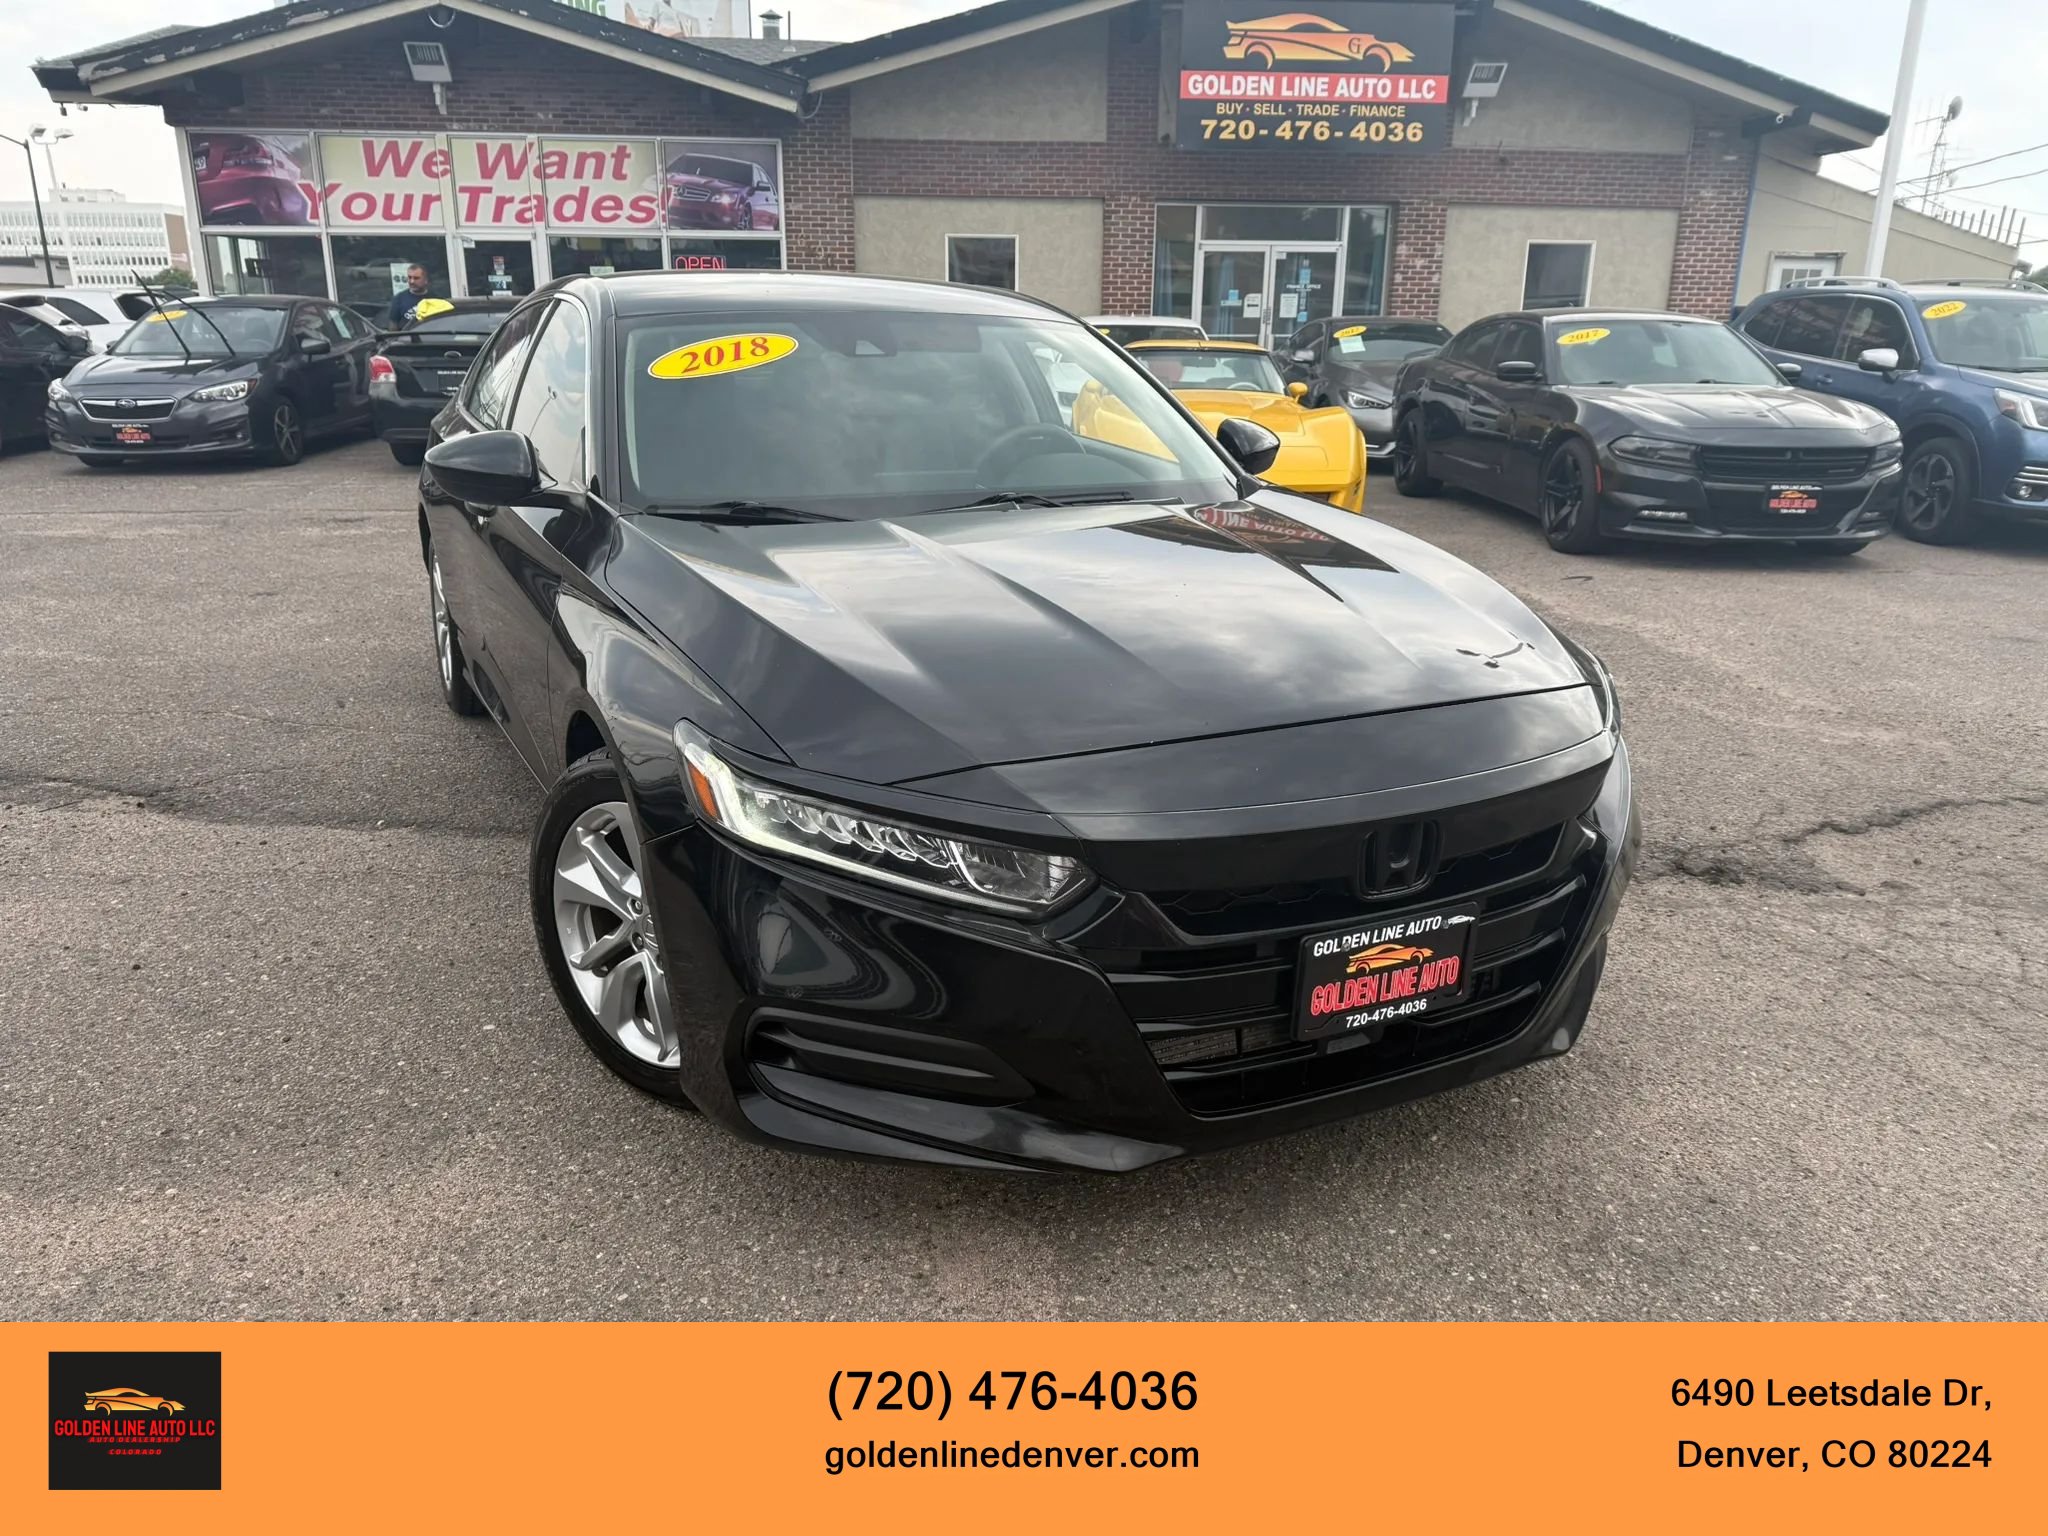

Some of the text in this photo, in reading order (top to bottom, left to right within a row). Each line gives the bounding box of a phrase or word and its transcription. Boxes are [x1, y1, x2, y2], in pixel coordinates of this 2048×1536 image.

[1188, 74, 1436, 99] GOLDEN LINE AUTO LLC
[1216, 103, 1406, 118] BUY SELL TRADE FINANCE
[362, 139, 632, 181] We Want
[298, 182, 673, 224] Your Trades!
[675, 255, 725, 270] OPEN
[1931, 303, 1959, 317] 2022
[1567, 329, 1600, 343] 2017
[680, 336, 770, 374] 2018
[1313, 916, 1442, 957] GOLDEN LINE AUTO
[1311, 955, 1460, 1016] GOLDEN LINE AUTO
[1346, 998, 1427, 1028] 720-476-4036
